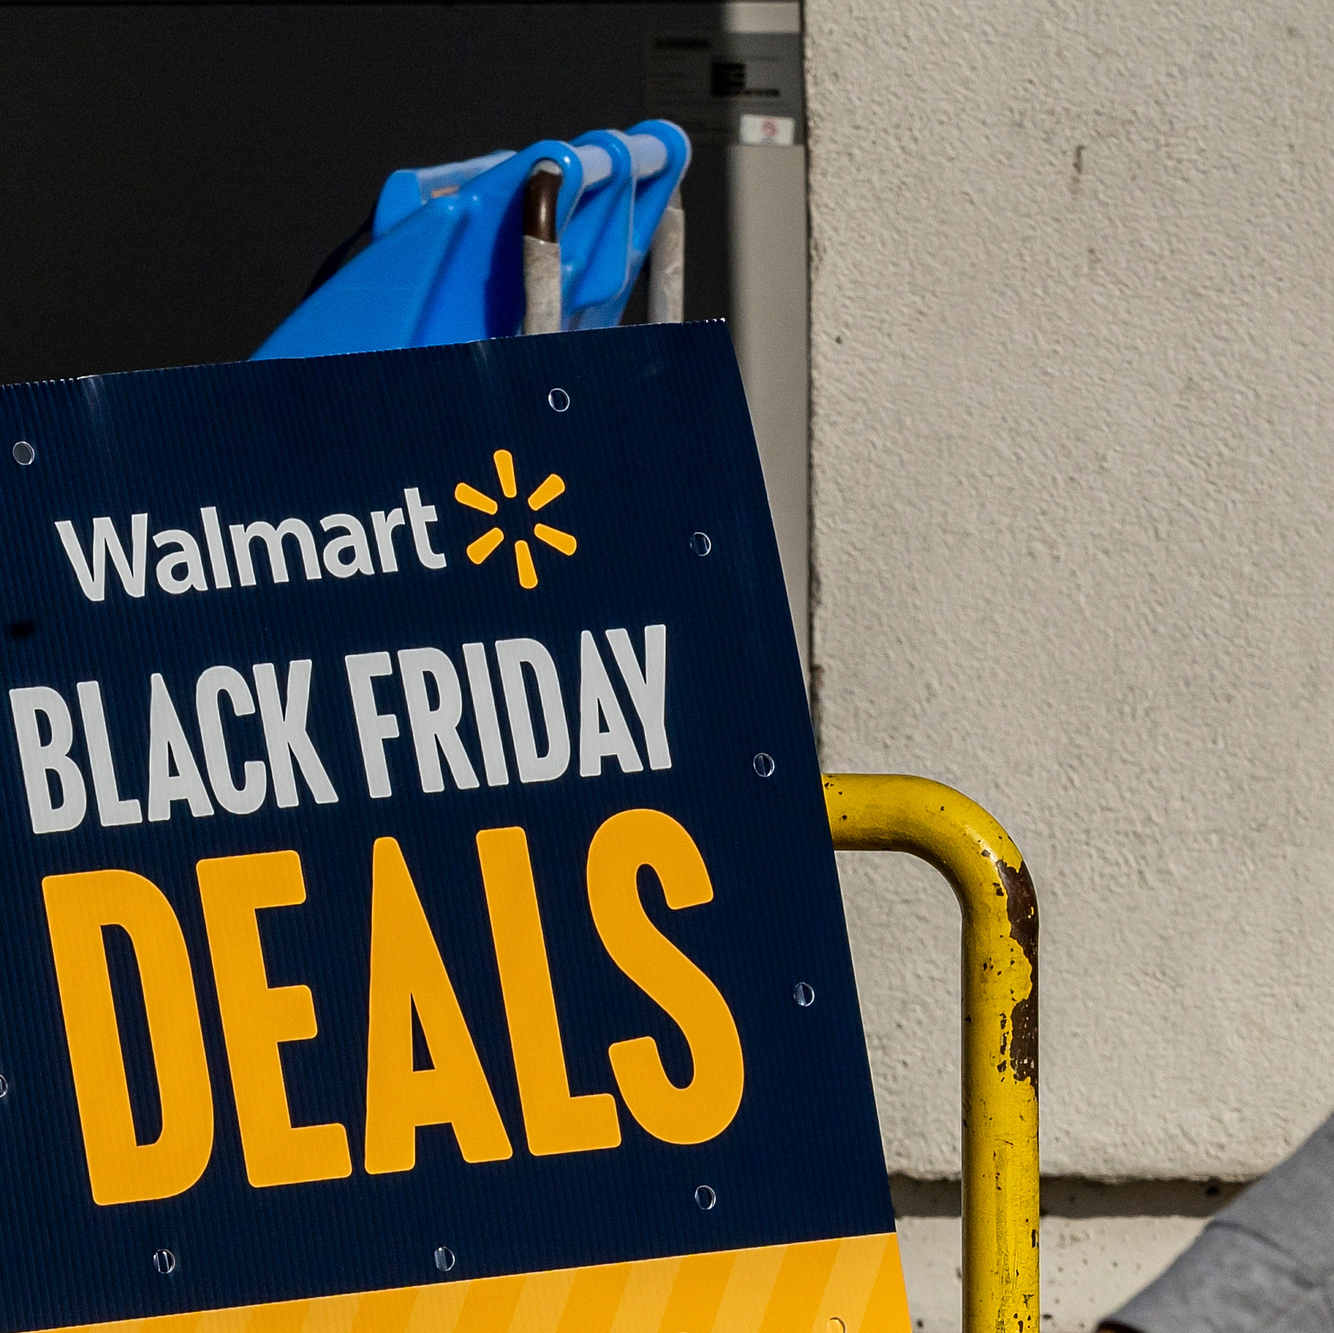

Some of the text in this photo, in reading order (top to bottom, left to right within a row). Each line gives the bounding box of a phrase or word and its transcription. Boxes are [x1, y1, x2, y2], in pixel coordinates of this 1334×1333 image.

[55, 487, 446, 601] Walmart
[9, 624, 672, 834] BLACK FRIDAY
[42, 809, 744, 1205] DEALS
